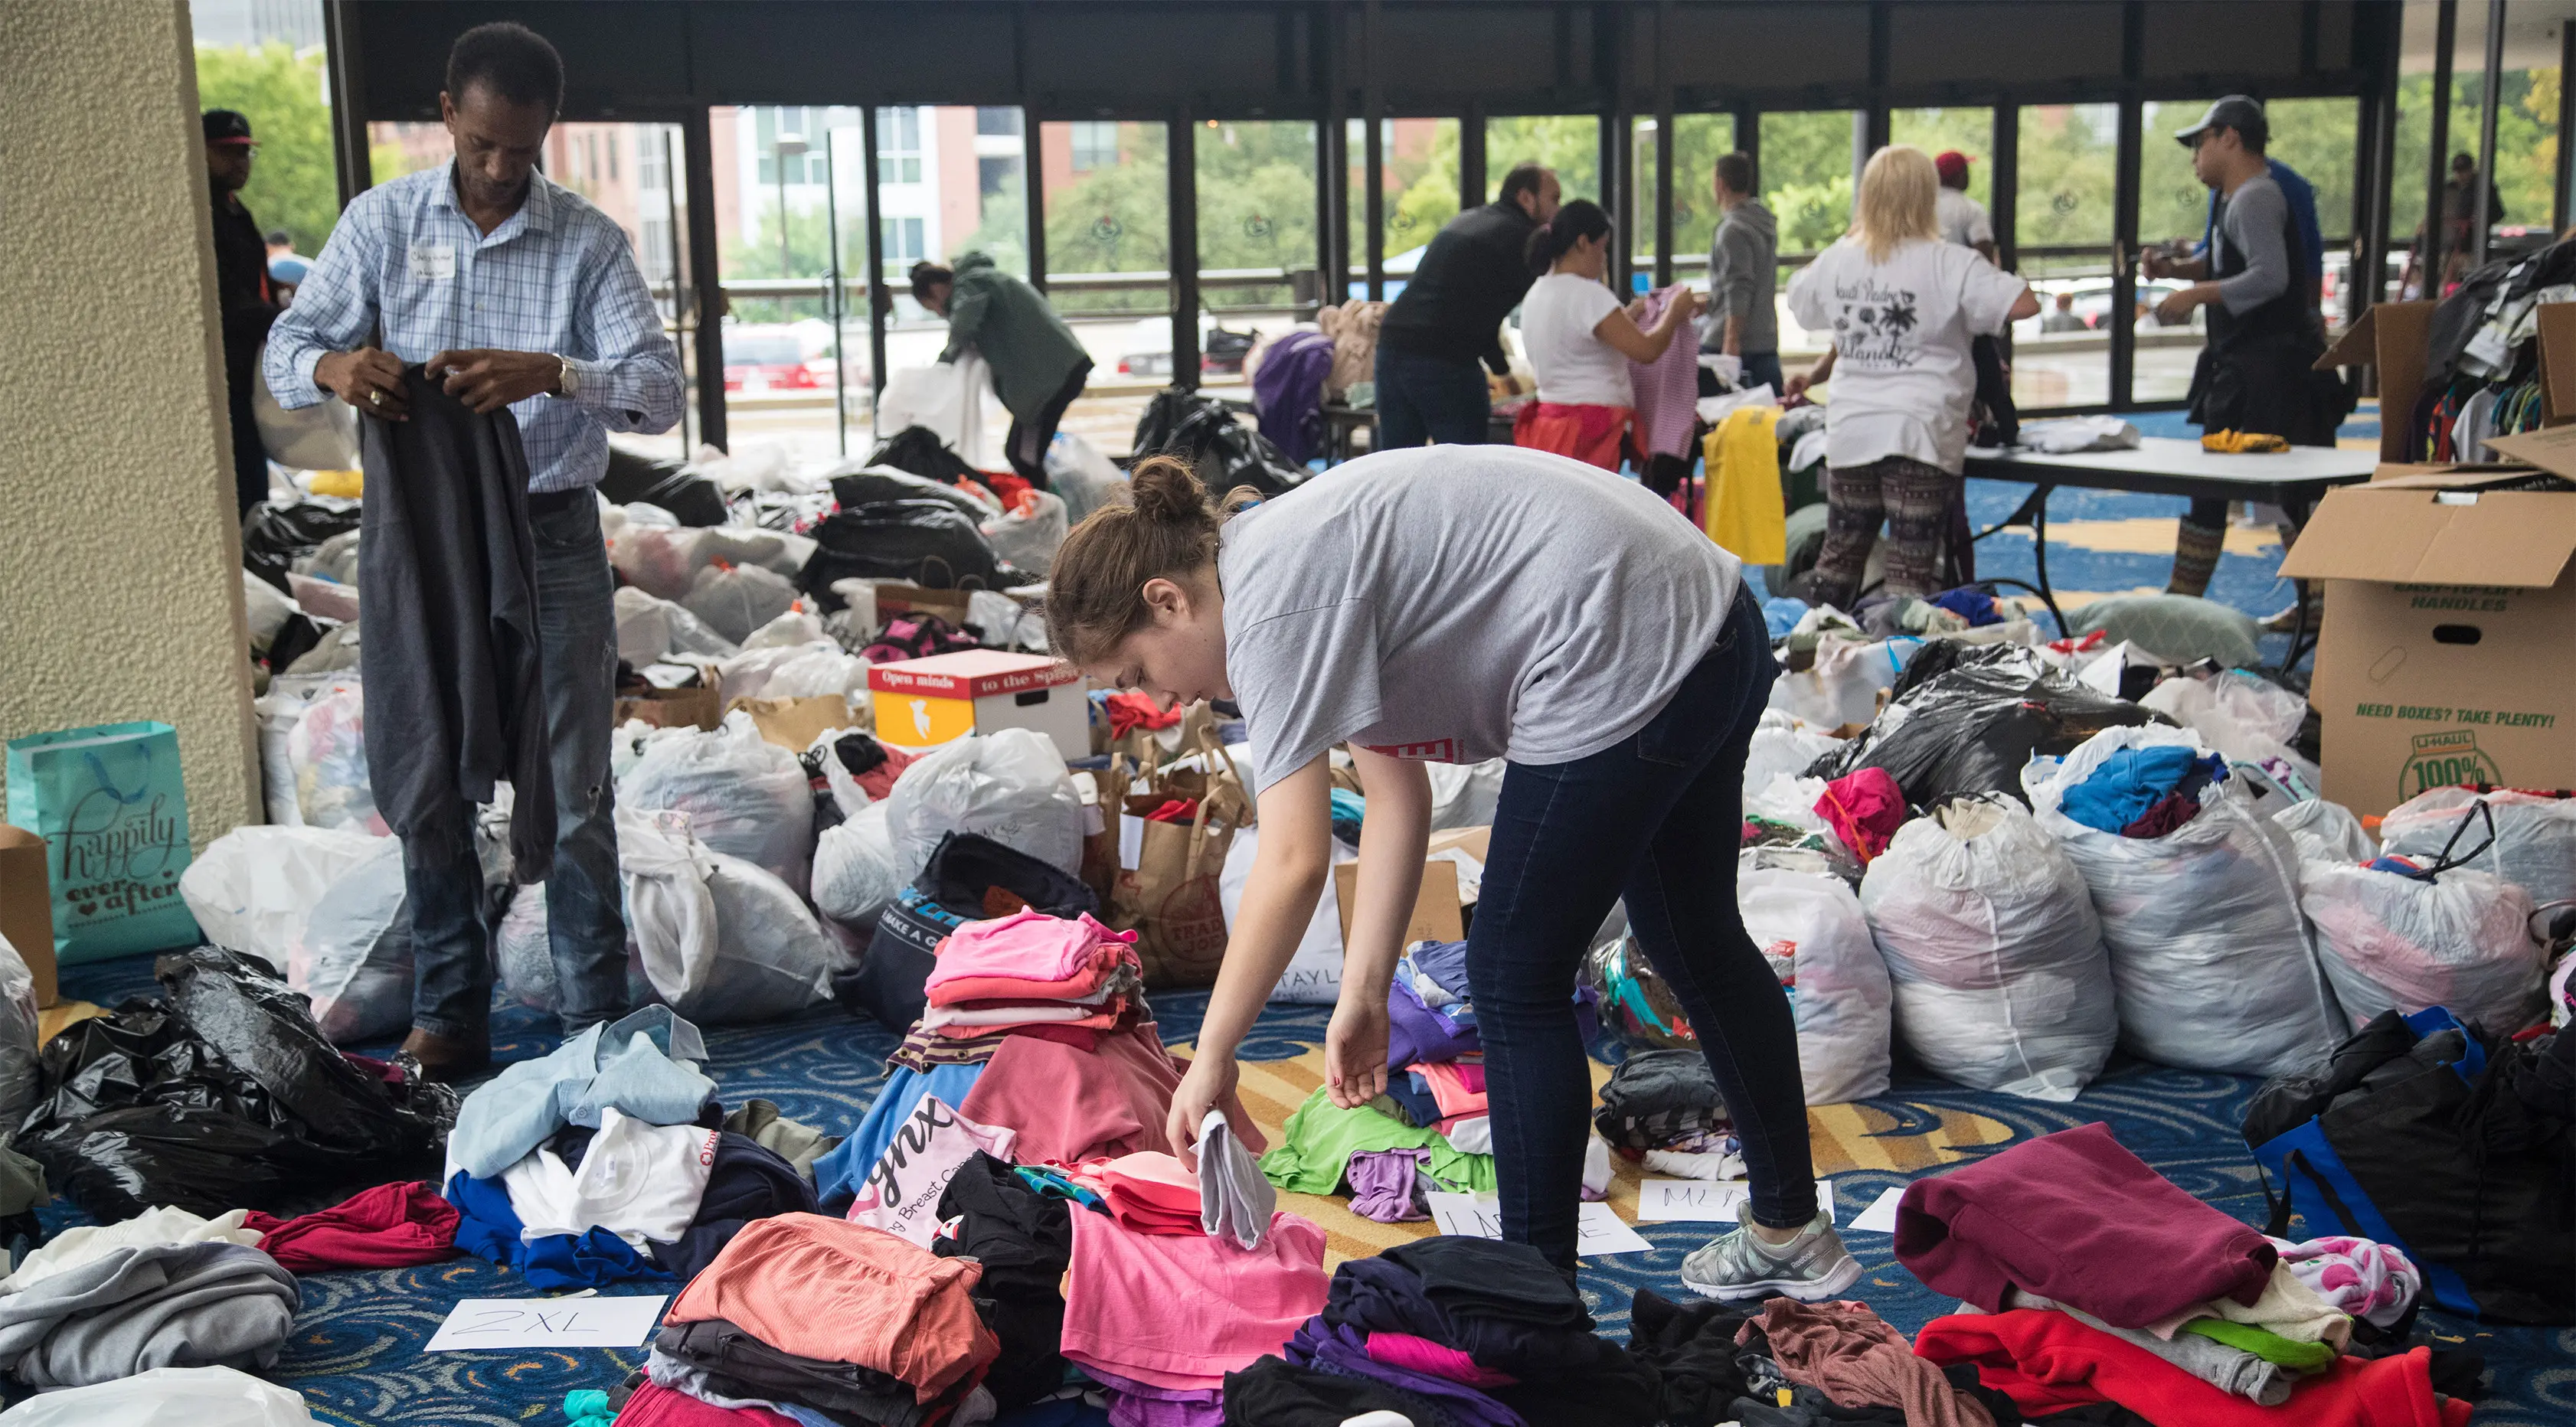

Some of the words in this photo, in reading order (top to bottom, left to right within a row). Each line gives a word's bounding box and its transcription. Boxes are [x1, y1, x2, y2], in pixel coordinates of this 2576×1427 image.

[2411, 596, 2507, 612] HANDLES
[881, 670, 913, 687] Open
[916, 673, 955, 689] minds
[982, 680, 998, 691] to
[1003, 674, 1029, 688] the
[2356, 703, 2393, 718] NEED
[2398, 705, 2453, 722] BOXES?
[2457, 708, 2492, 725] TAKE
[2495, 711, 2556, 729] PLENTY!
[2417, 735, 2472, 748] U-HAUL
[2413, 753, 2486, 791] 100%
[47, 787, 189, 881] happily
[67, 878, 127, 902] ever
[106, 882, 179, 916] after
[909, 929, 921, 942] A
[1280, 968, 1344, 988] TAYL
[899, 1180, 943, 1220] Breast
[1790, 1249, 1817, 1271] Reebok
[452, 1310, 600, 1335] 2XL
